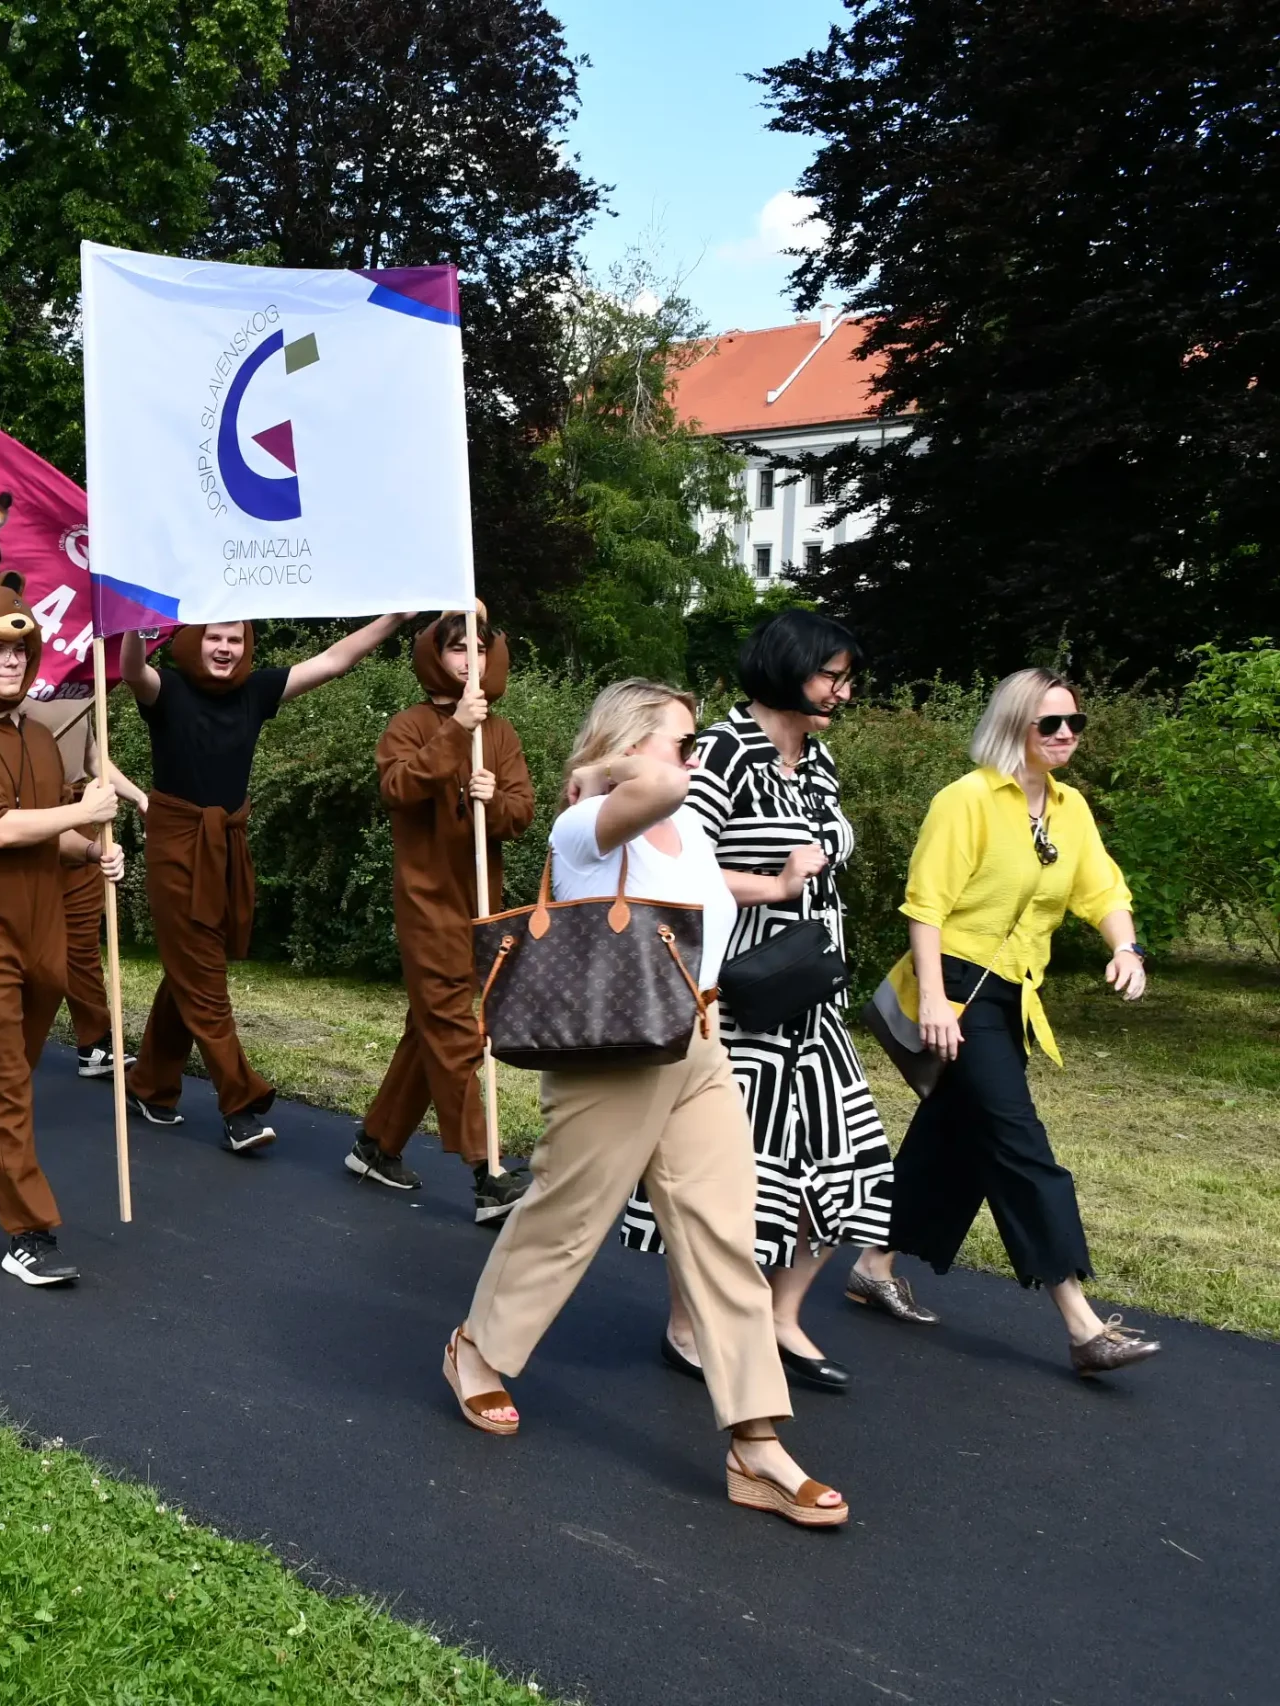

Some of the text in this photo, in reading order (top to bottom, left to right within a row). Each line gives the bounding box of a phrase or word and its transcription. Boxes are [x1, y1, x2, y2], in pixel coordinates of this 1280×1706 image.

[198, 304, 280, 519] JOSIPA SLAVENSKOG
[222, 538, 312, 560] GIMNAZIJA
[223, 564, 312, 586] ČAKOVEC
